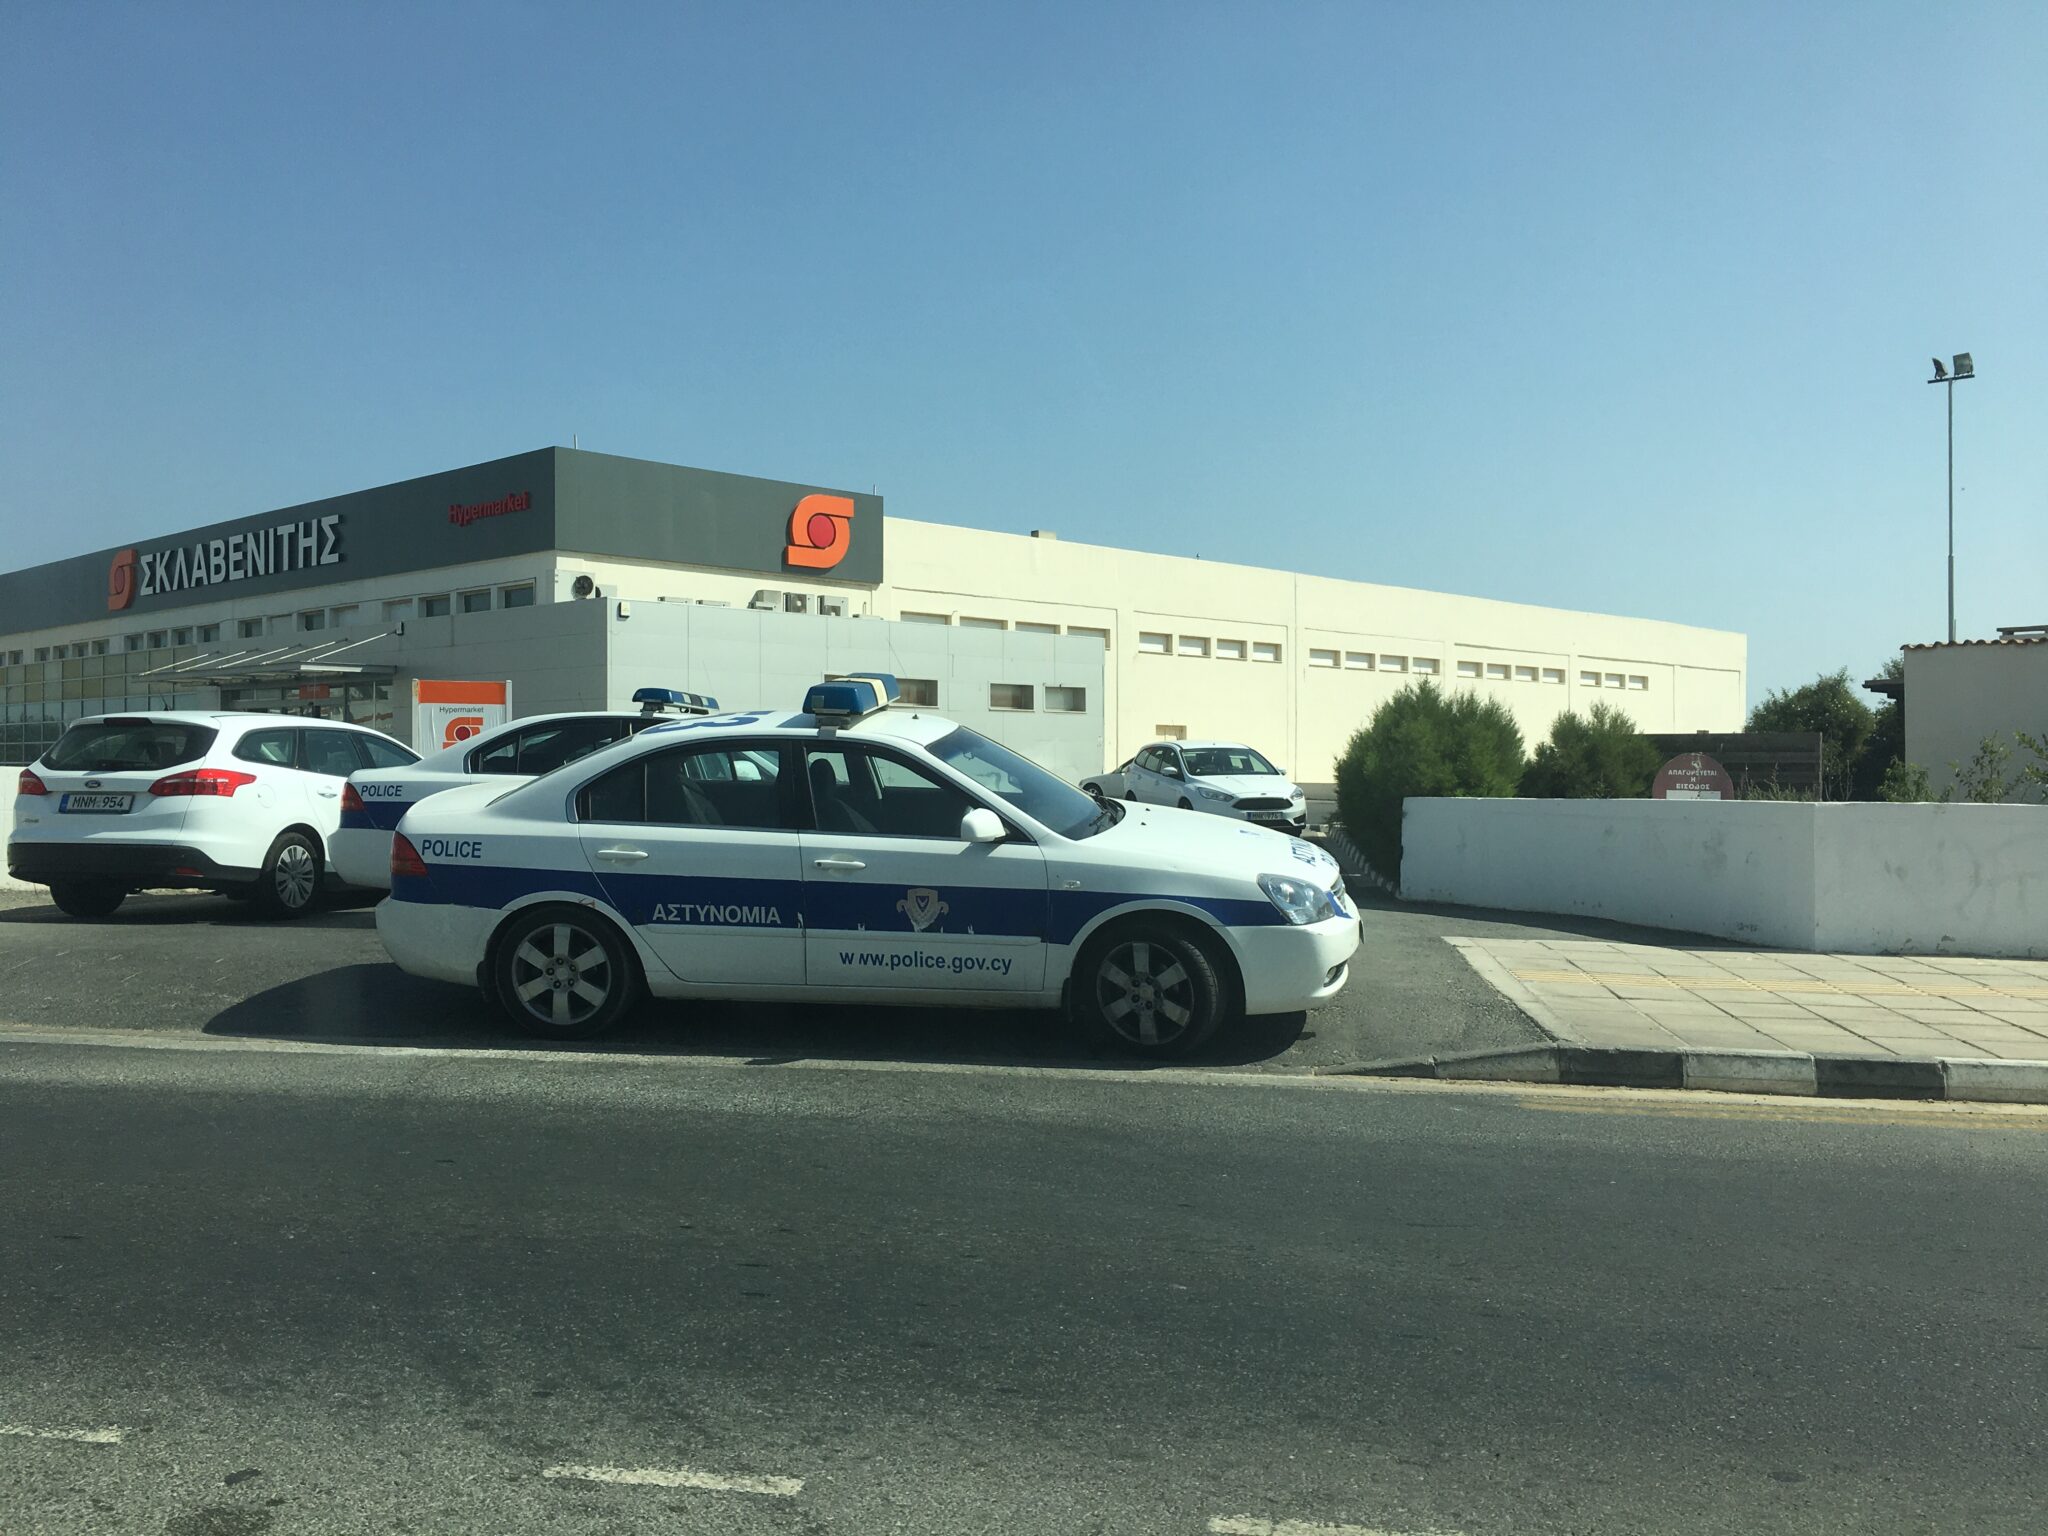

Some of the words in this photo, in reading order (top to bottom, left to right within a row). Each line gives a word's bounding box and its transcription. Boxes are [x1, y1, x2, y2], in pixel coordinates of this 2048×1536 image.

[448, 491, 530, 527] Hypermarket
[139, 514, 340, 596] ΣΚΛΑΒΕΝΙΤΗΣ
[439, 706, 484, 714] Hypermarket
[361, 785, 402, 797] POLICE
[72, 797, 97, 808] MNM
[102, 796, 124, 808] 954
[421, 839, 482, 858] POLICE
[652, 903, 781, 924] ΑΣΤΥΝΟΜΙΑ
